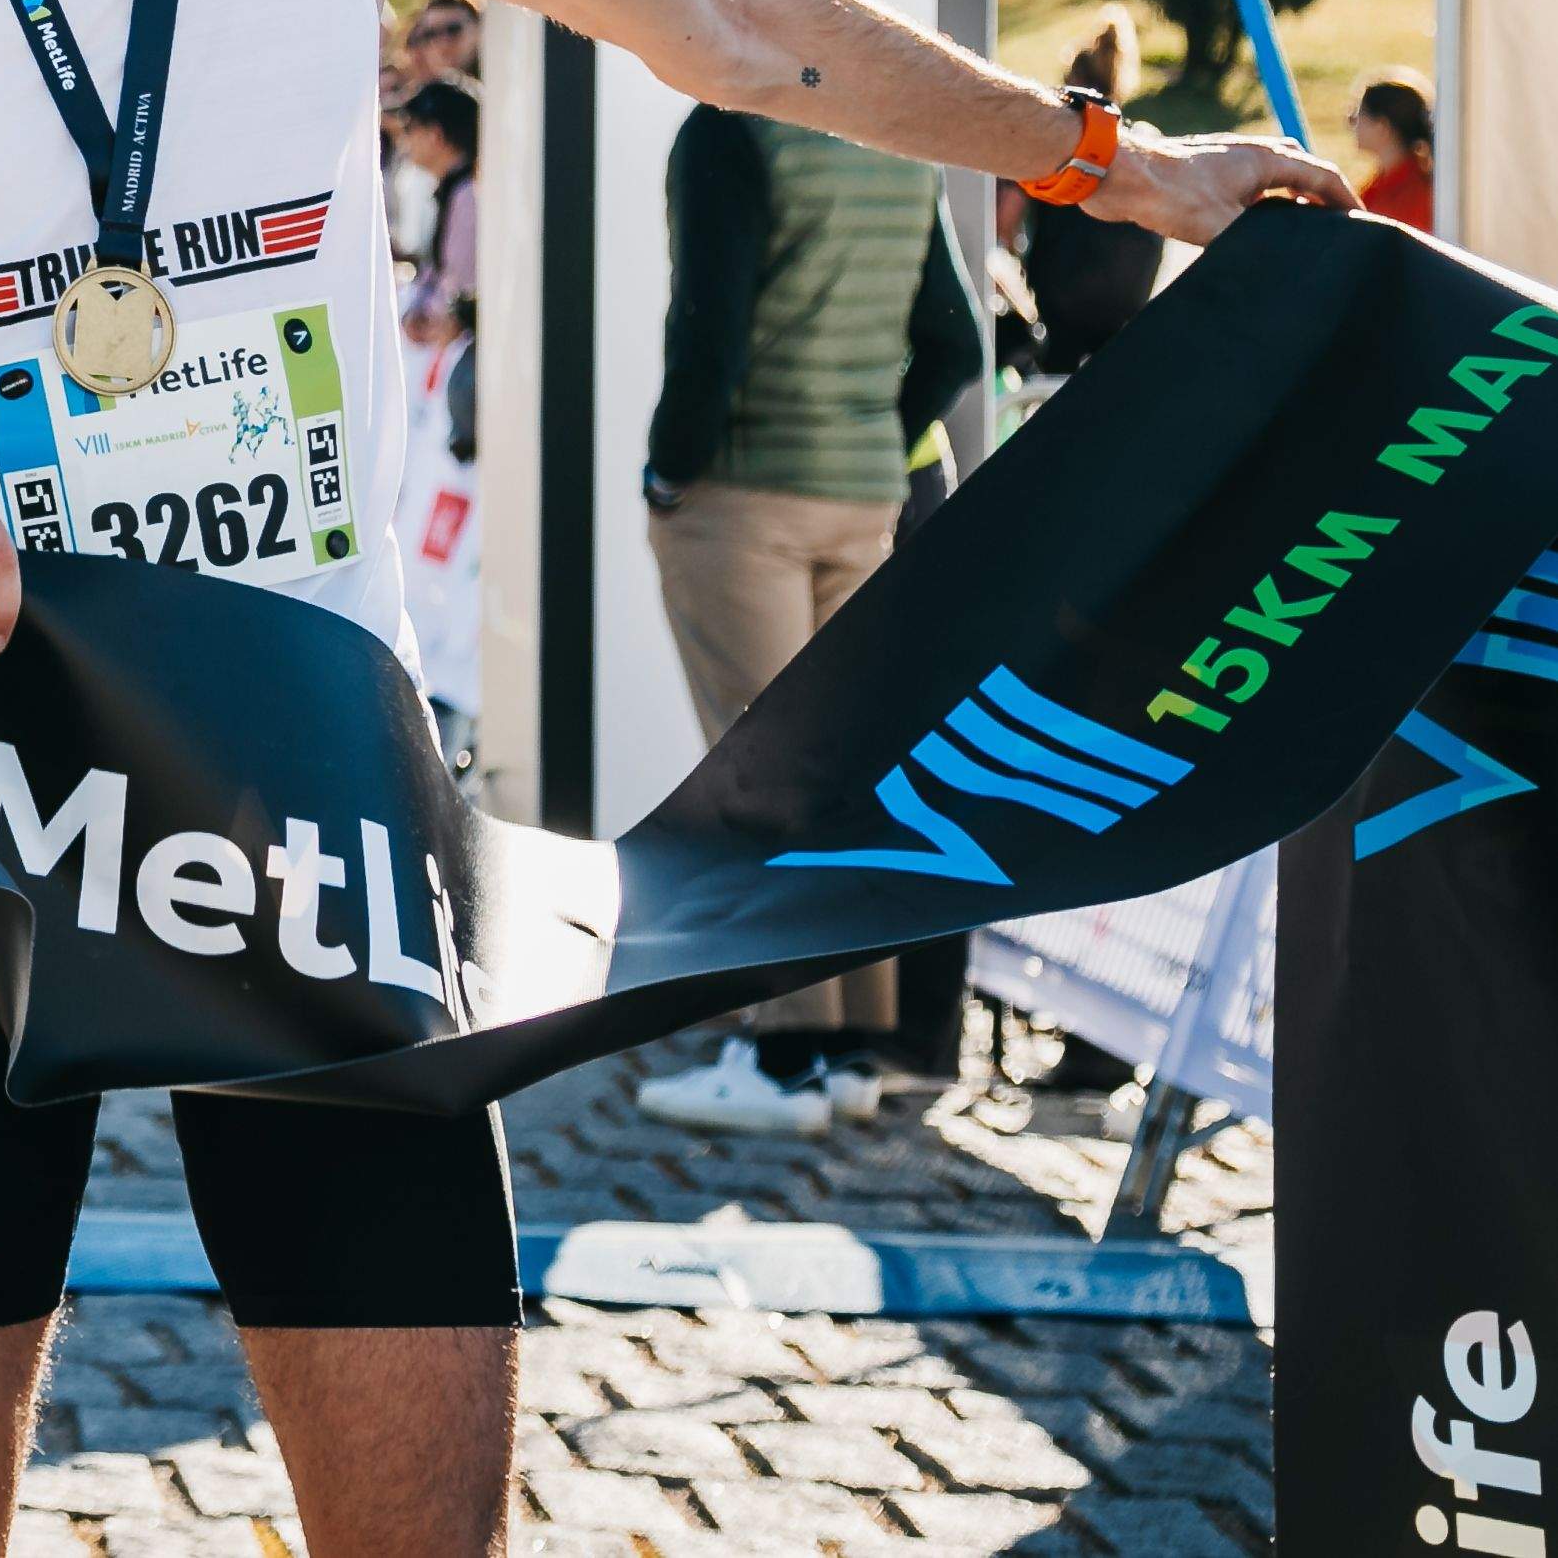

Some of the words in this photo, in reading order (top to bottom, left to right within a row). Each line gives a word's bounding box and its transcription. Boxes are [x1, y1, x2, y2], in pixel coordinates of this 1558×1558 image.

[36, 21, 77, 92] MetLife
[121, 150, 142, 213] MADRID
[133, 92, 152, 146] ACTIVA
[172, 209, 262, 272] RUN
[129, 347, 269, 399] etLife
[74, 432, 112, 459] VIII
[114, 437, 143, 452] 15KM
[144, 429, 187, 449] MADRID
[90, 472, 298, 574] 3262
[764, 663, 1196, 886] VIII
[1148, 510, 1400, 734] 15KM
